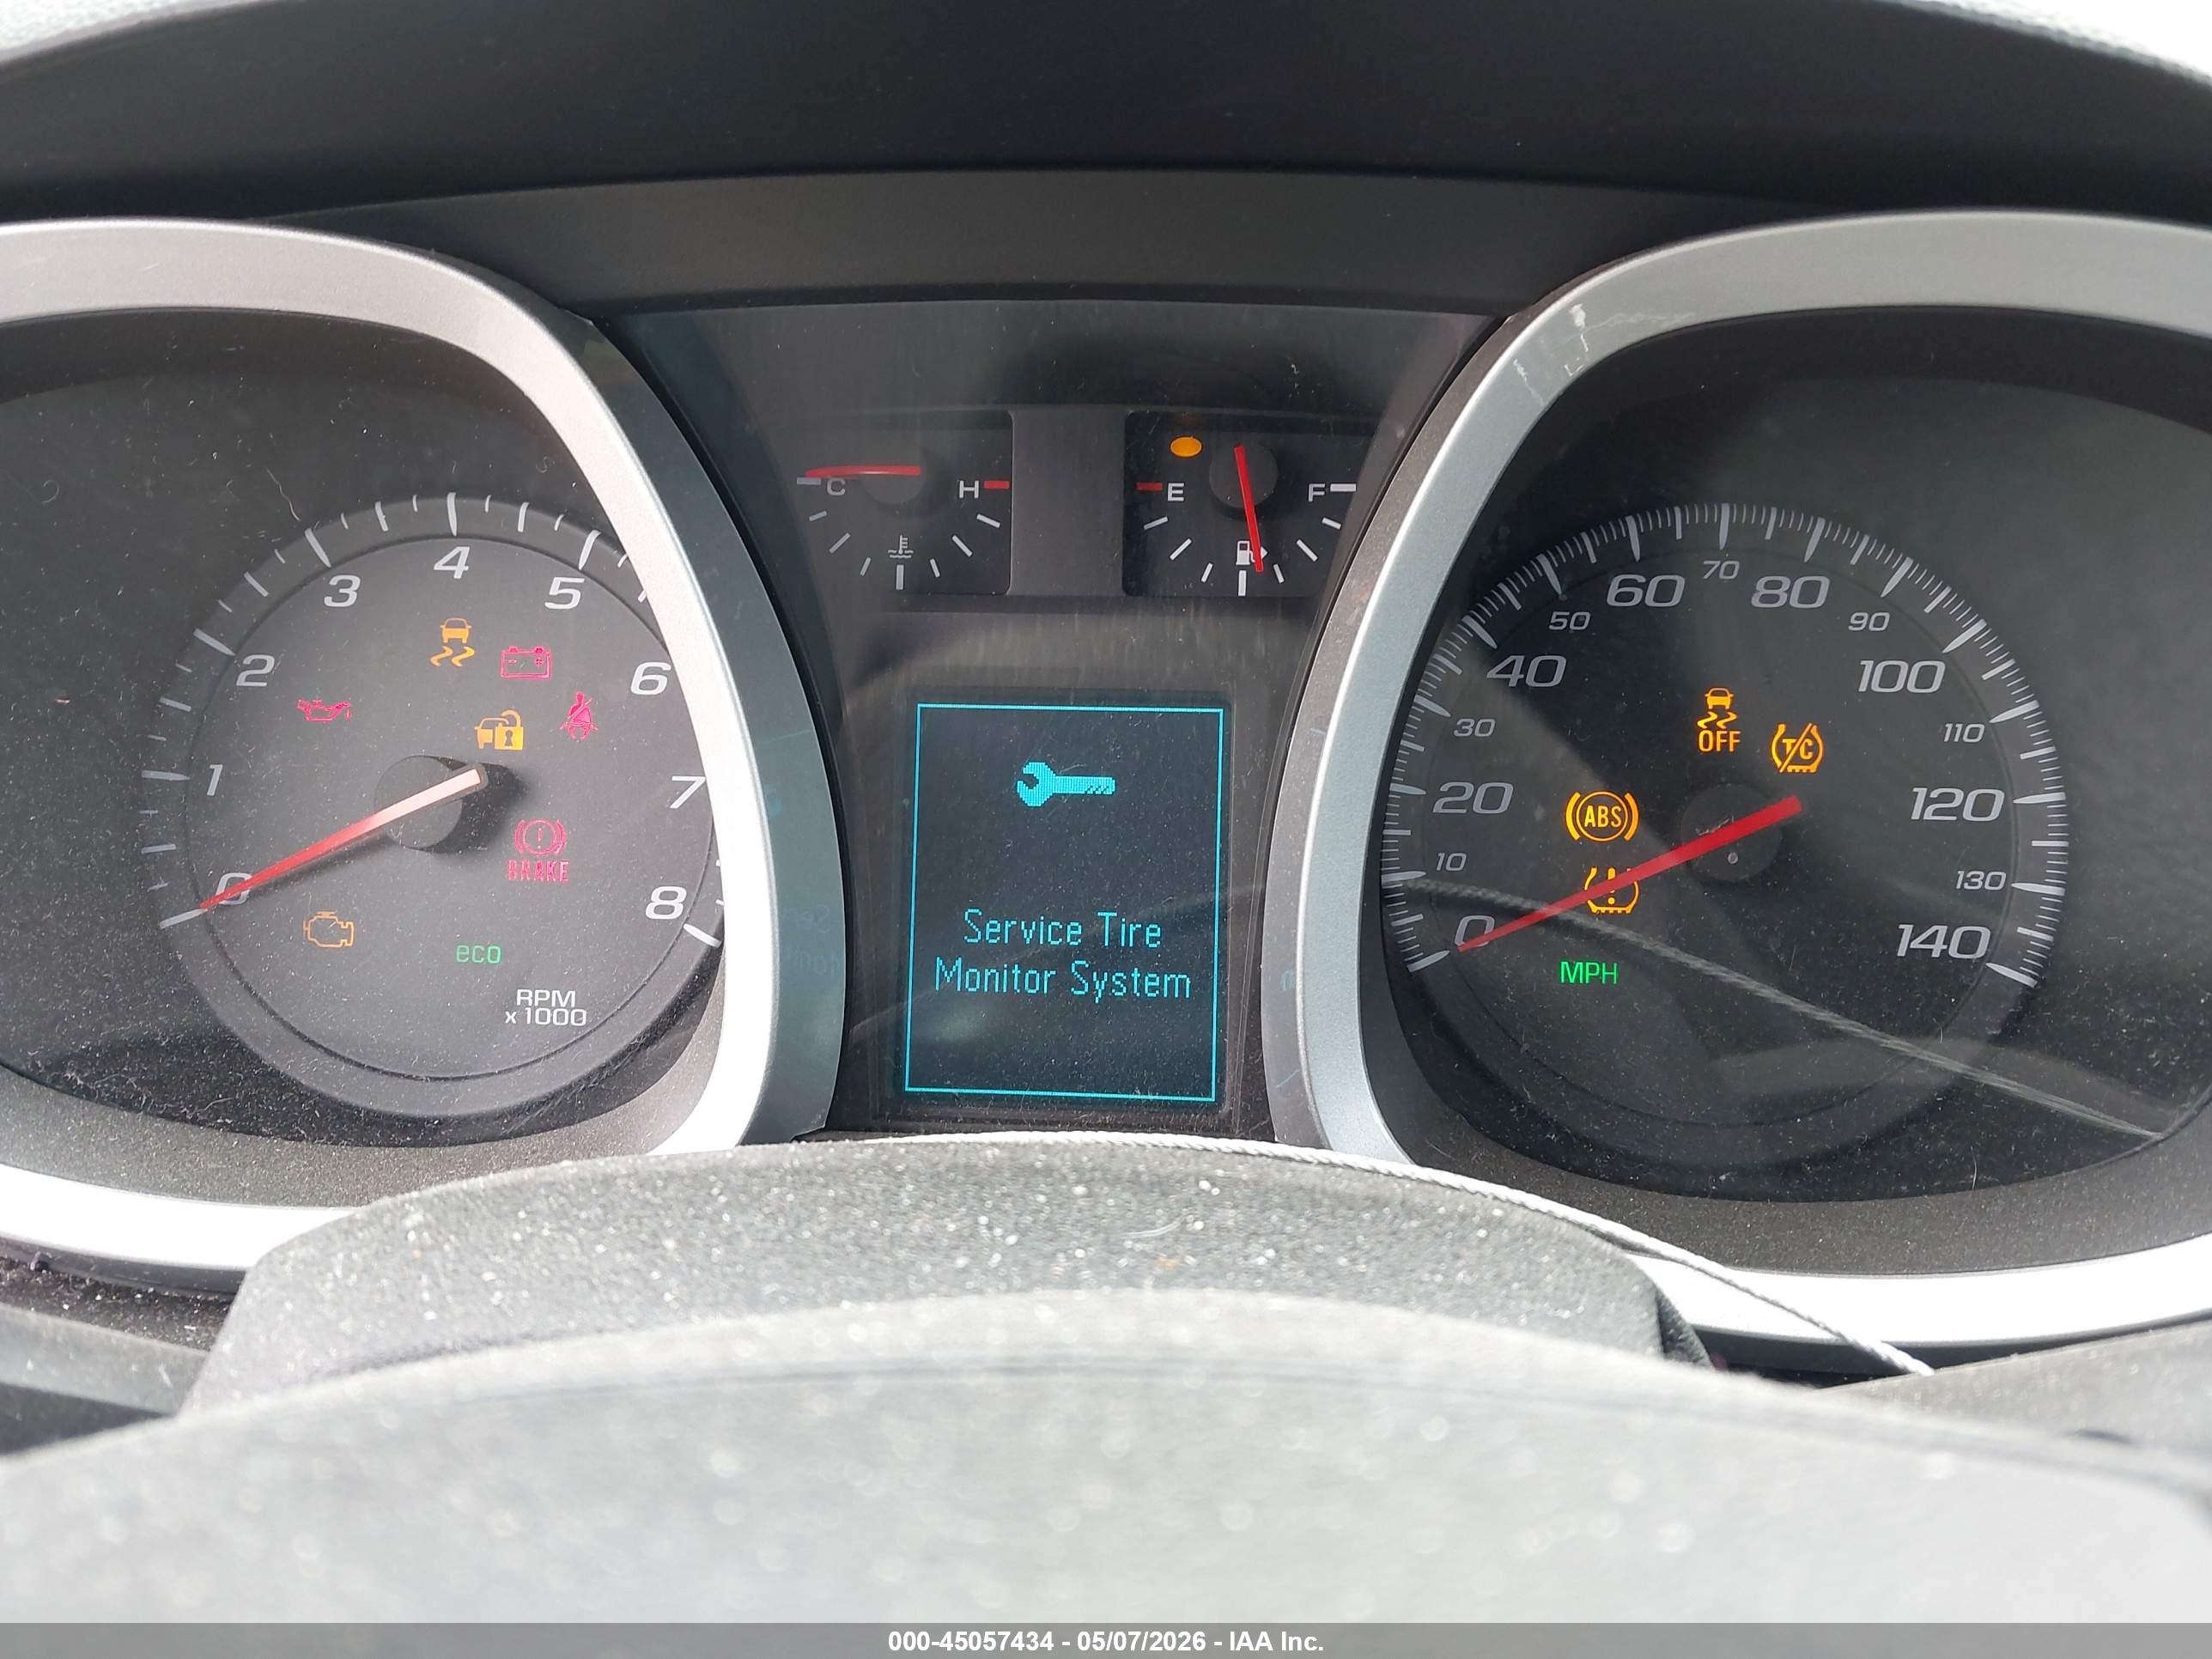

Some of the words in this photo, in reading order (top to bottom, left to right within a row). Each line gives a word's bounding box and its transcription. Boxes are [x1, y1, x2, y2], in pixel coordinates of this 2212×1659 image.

[826, 478, 846, 496] C
[959, 480, 980, 499] H
[1167, 483, 1185, 502] E
[1308, 483, 1326, 502] F
[434, 546, 471, 580] 4
[1703, 560, 1740, 580] 70
[323, 574, 362, 608] 3
[544, 576, 585, 610] 5
[1606, 574, 1686, 607] 60
[1751, 575, 1831, 609] 80
[1548, 611, 1591, 630] 50
[1848, 611, 1890, 632] 90
[235, 654, 276, 688] 2
[630, 661, 672, 696] 6
[1486, 655, 1567, 688] 40
[1857, 659, 1946, 694] 100
[1453, 718, 1496, 738] 30
[1698, 730, 1741, 752] OFF
[1943, 723, 1985, 743] 110
[206, 763, 223, 796] 1
[669, 775, 706, 809] 7
[1432, 781, 1514, 814] 20
[1911, 787, 2005, 822] 120
[1583, 805, 1623, 829] ABS
[507, 860, 570, 883] BRAKE
[1436, 852, 1467, 872] 10
[1955, 870, 2007, 891] 130
[645, 885, 687, 920] 8
[963, 908, 1083, 945] Service
[1097, 911, 1162, 948] Tire
[1454, 915, 1496, 948] 0
[1896, 924, 1991, 959] 140
[455, 945, 502, 963] eco
[935, 956, 1057, 995] Monitor
[1070, 959, 1192, 1004] System
[1559, 961, 1618, 984] MPH
[516, 988, 576, 1007] RPM
